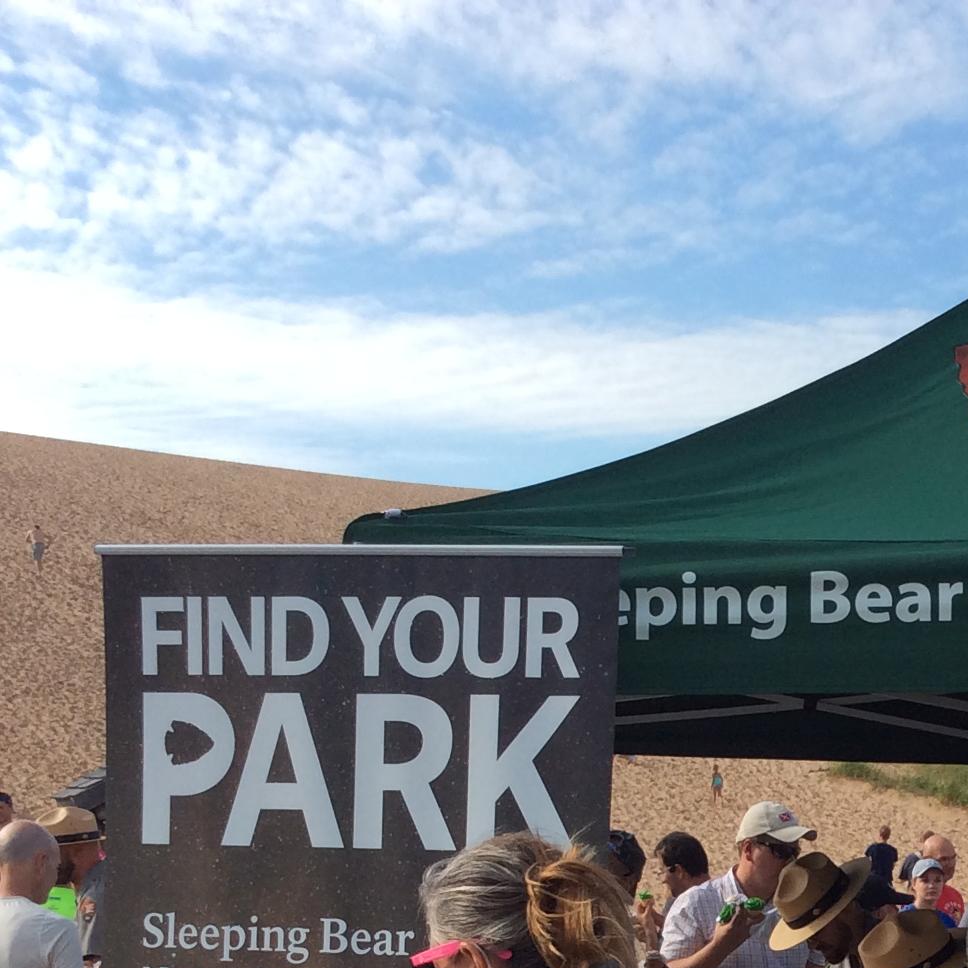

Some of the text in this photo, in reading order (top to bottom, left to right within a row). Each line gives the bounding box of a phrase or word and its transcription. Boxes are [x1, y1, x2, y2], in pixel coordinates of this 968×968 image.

[810, 570, 964, 624] Bear
[140, 594, 581, 679] FIND YOUR
[141, 691, 581, 851] PARK
[142, 911, 415, 965] Sleeping Bear
